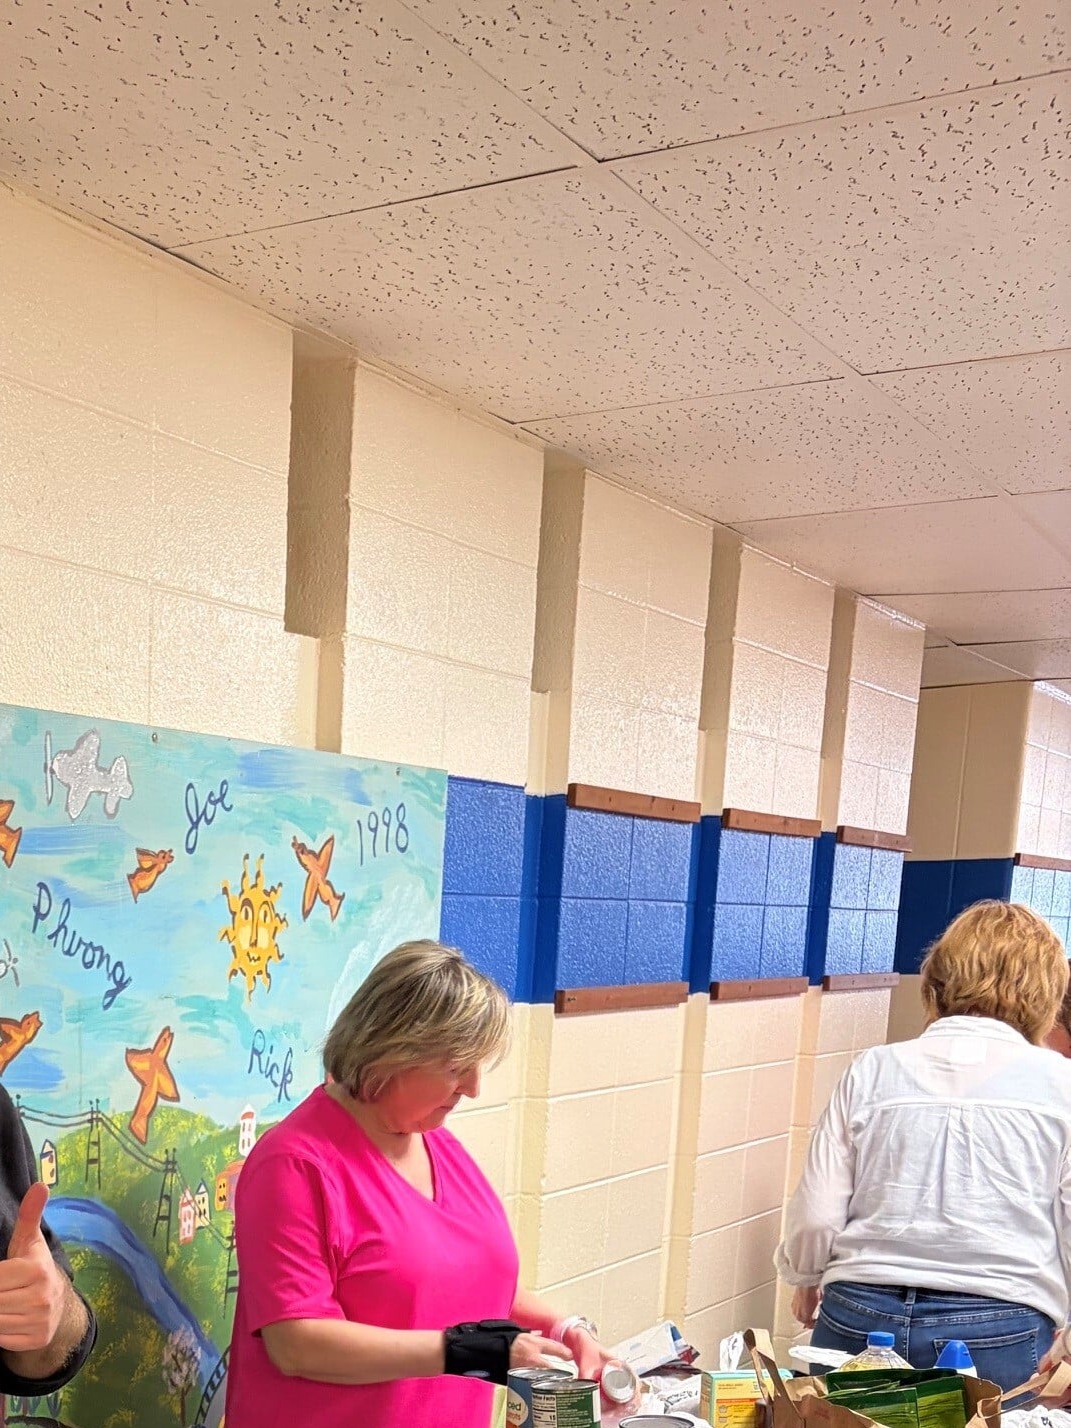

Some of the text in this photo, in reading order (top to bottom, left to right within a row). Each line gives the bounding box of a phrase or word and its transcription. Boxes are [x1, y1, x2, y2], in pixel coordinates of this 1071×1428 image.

[184, 780, 233, 855] Joe
[356, 803, 409, 866] 1998
[248, 1029, 295, 1103] Rick
